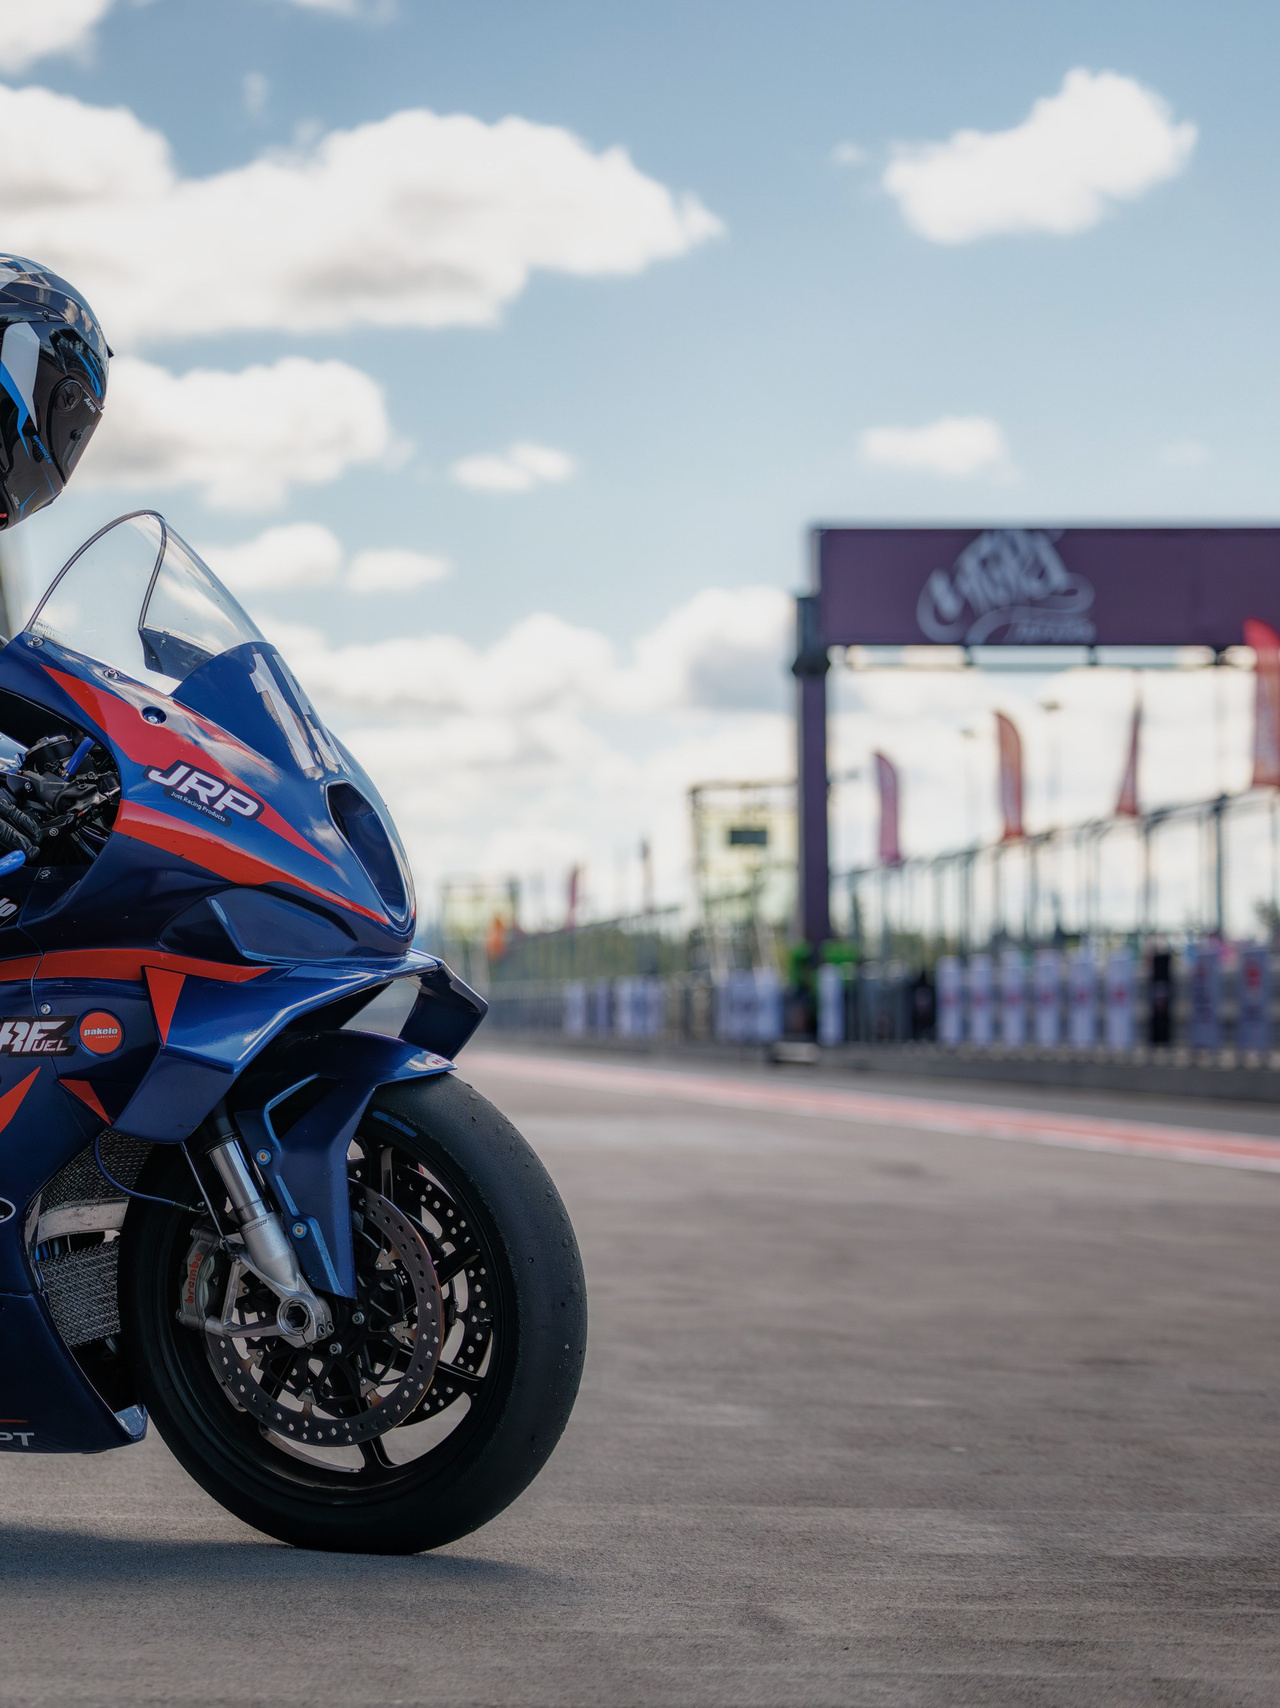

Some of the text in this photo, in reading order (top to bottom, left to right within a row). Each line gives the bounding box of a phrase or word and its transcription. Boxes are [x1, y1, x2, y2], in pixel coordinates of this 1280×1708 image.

[148, 764, 259, 817] JRP
[170, 791, 226, 822] Just Racing Products
[84, 1027, 119, 1037] pakelo
[184, 1253, 202, 1304] brembo
